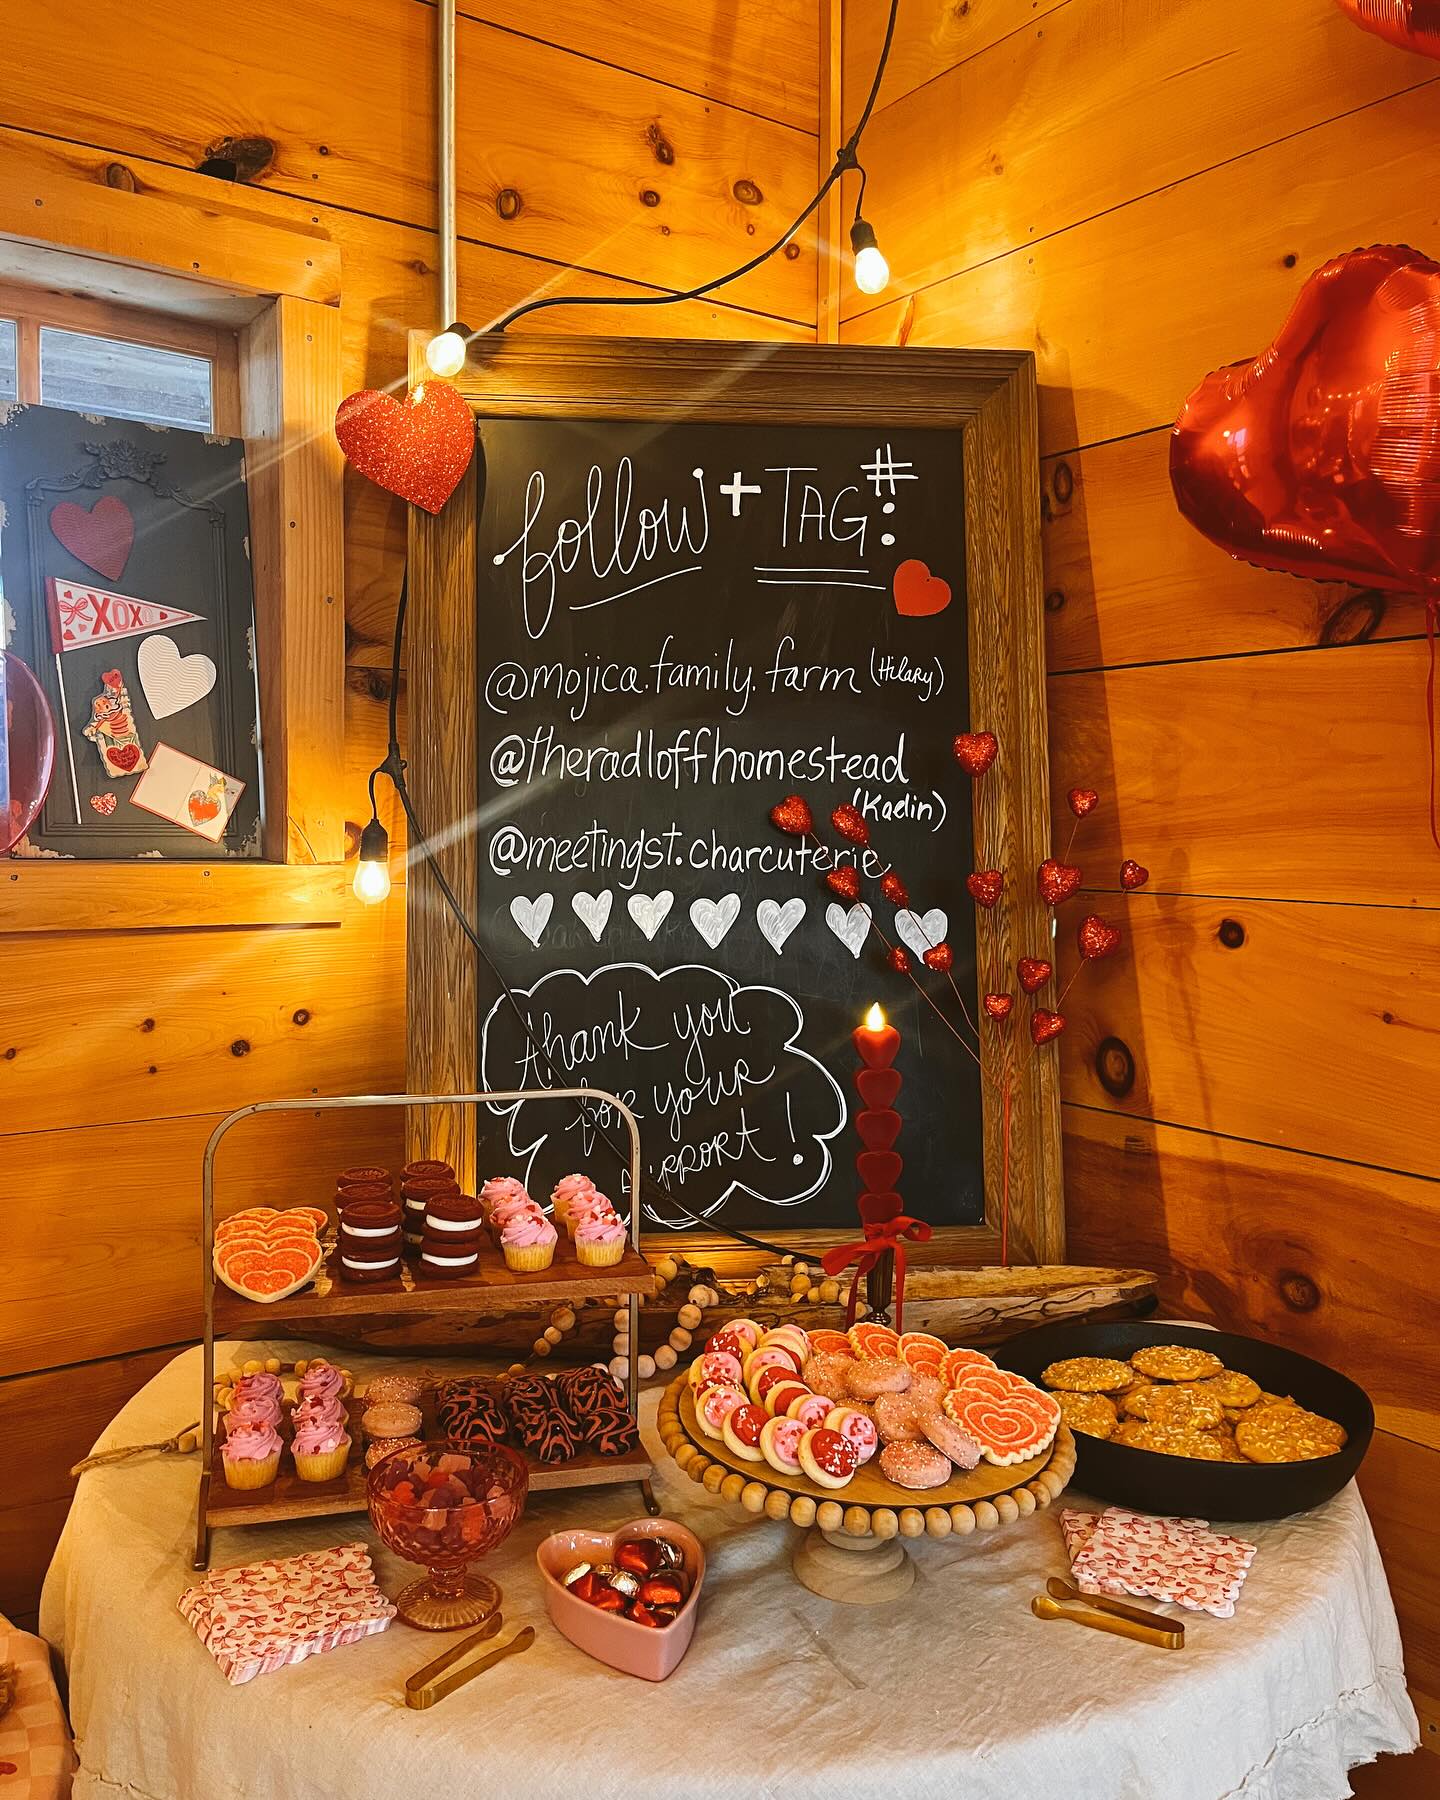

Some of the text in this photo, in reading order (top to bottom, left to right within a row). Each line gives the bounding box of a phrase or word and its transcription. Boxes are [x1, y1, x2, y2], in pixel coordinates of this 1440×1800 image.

[493, 457, 708, 639] follow
[87, 593, 154, 635] XOXO
[489, 725, 909, 789] @theradloffhomestead
[488, 819, 893, 890] @meetingst.charcuterie
